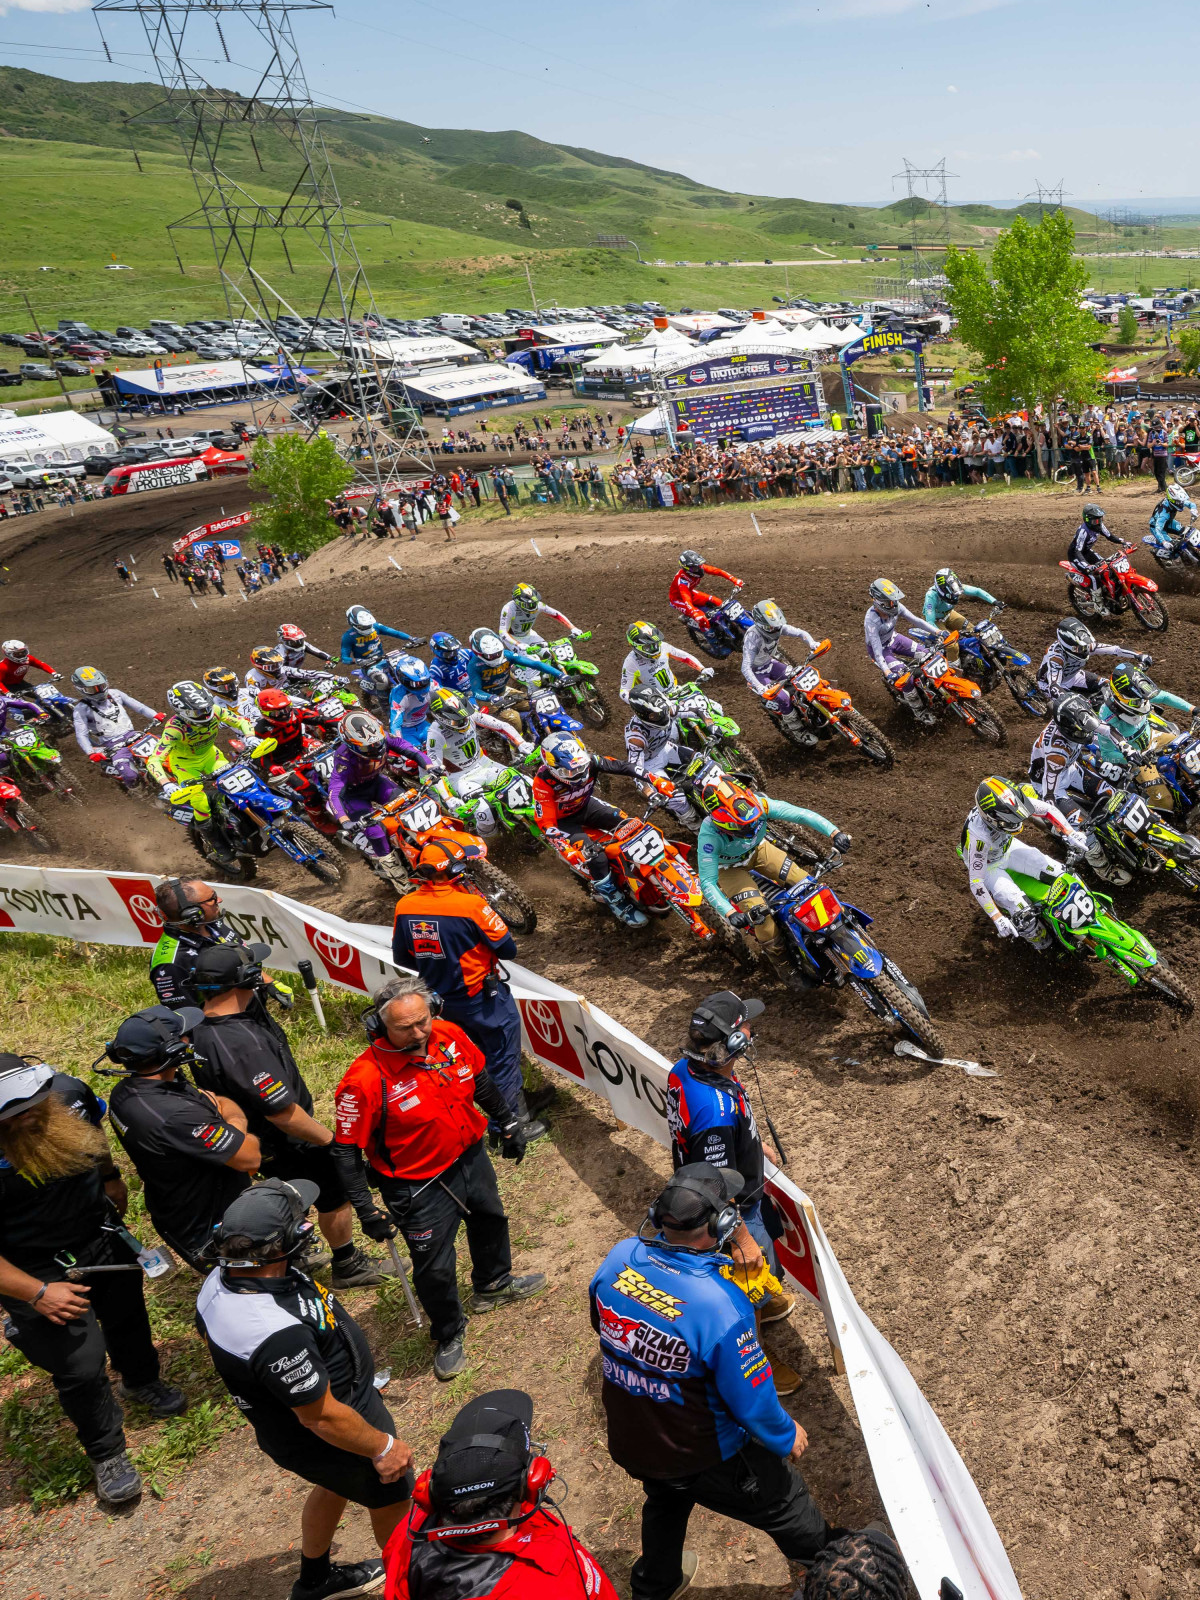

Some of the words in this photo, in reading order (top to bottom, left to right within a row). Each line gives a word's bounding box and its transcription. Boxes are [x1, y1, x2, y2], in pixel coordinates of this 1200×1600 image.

[862, 332, 903, 352] FINISH
[731, 355, 747, 363] 2025
[710, 364, 770, 378] MOTOCROSS
[711, 371, 771, 382] CHAMPIONSHIP
[138, 462, 193, 480] ALPINESTARS
[135, 473, 191, 491] PROTECTS
[210, 516, 242, 532] GASGAS
[355, 631, 378, 643] THOR
[555, 646, 574, 662] 98
[482, 663, 509, 677] THOR
[927, 657, 948, 679] 775
[536, 695, 560, 714] 451
[223, 768, 257, 795] 92
[1099, 761, 1123, 782] 93
[507, 780, 531, 809] 47
[172, 810, 194, 823] 92
[402, 799, 442, 832] 142
[1124, 797, 1151, 833] 107
[628, 829, 665, 865] 23
[810, 893, 830, 928] 1
[1062, 889, 1094, 928] 26
[224, 910, 288, 949] OTA
[160, 940, 171, 956] FOX
[851, 981, 876, 1010] DUNLOP
[574, 1025, 668, 1119] TOYO
[704, 1142, 726, 1154] Mika
[617, 1263, 687, 1306] ROCK
[611, 1276, 683, 1319] RIVER
[633, 1321, 690, 1359] GIZMO
[736, 1328, 754, 1347] Mik
[744, 1357, 768, 1379] HINSO
[612, 1362, 671, 1399] YAMAHA
[453, 1481, 495, 1495] MAKSON
